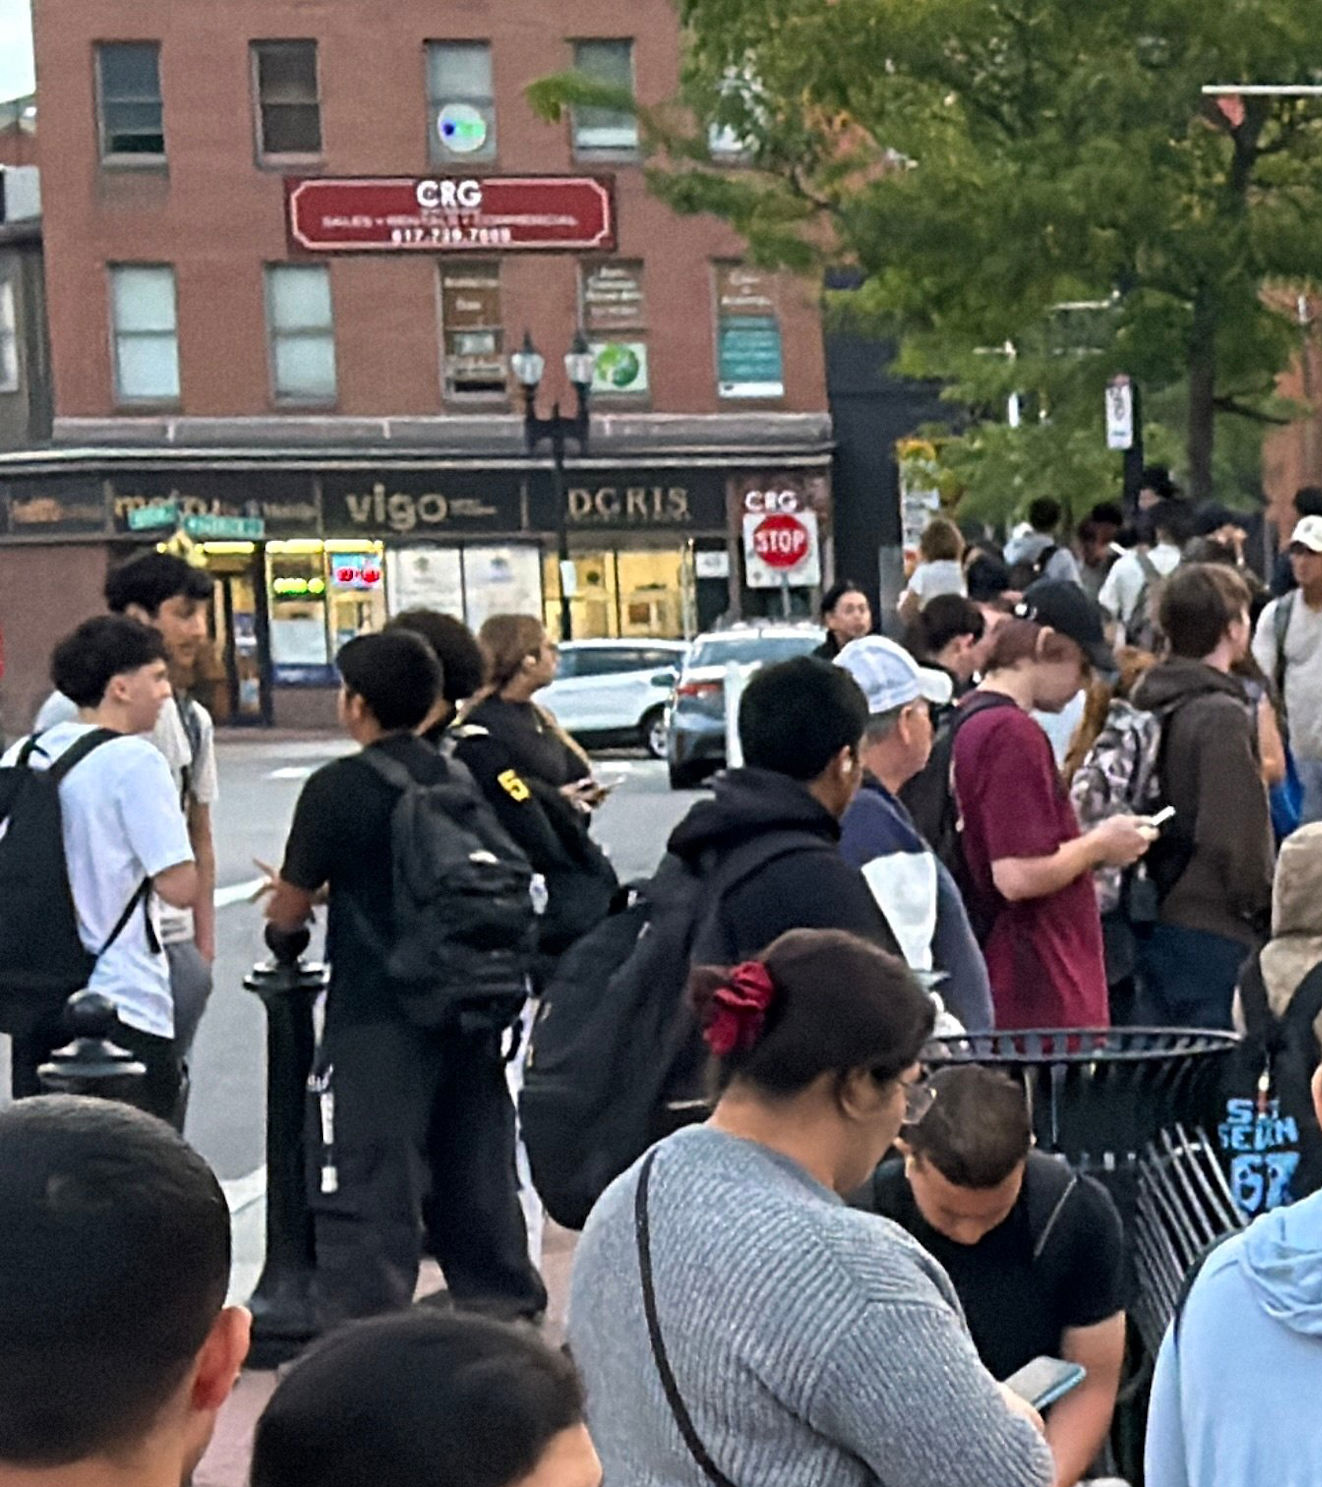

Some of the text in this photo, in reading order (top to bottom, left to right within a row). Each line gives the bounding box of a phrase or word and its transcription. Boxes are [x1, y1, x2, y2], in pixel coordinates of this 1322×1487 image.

[416, 180, 482, 207] CRG
[346, 482, 448, 531] vigo
[745, 490, 797, 513] CRG
[757, 530, 805, 553] STOP
